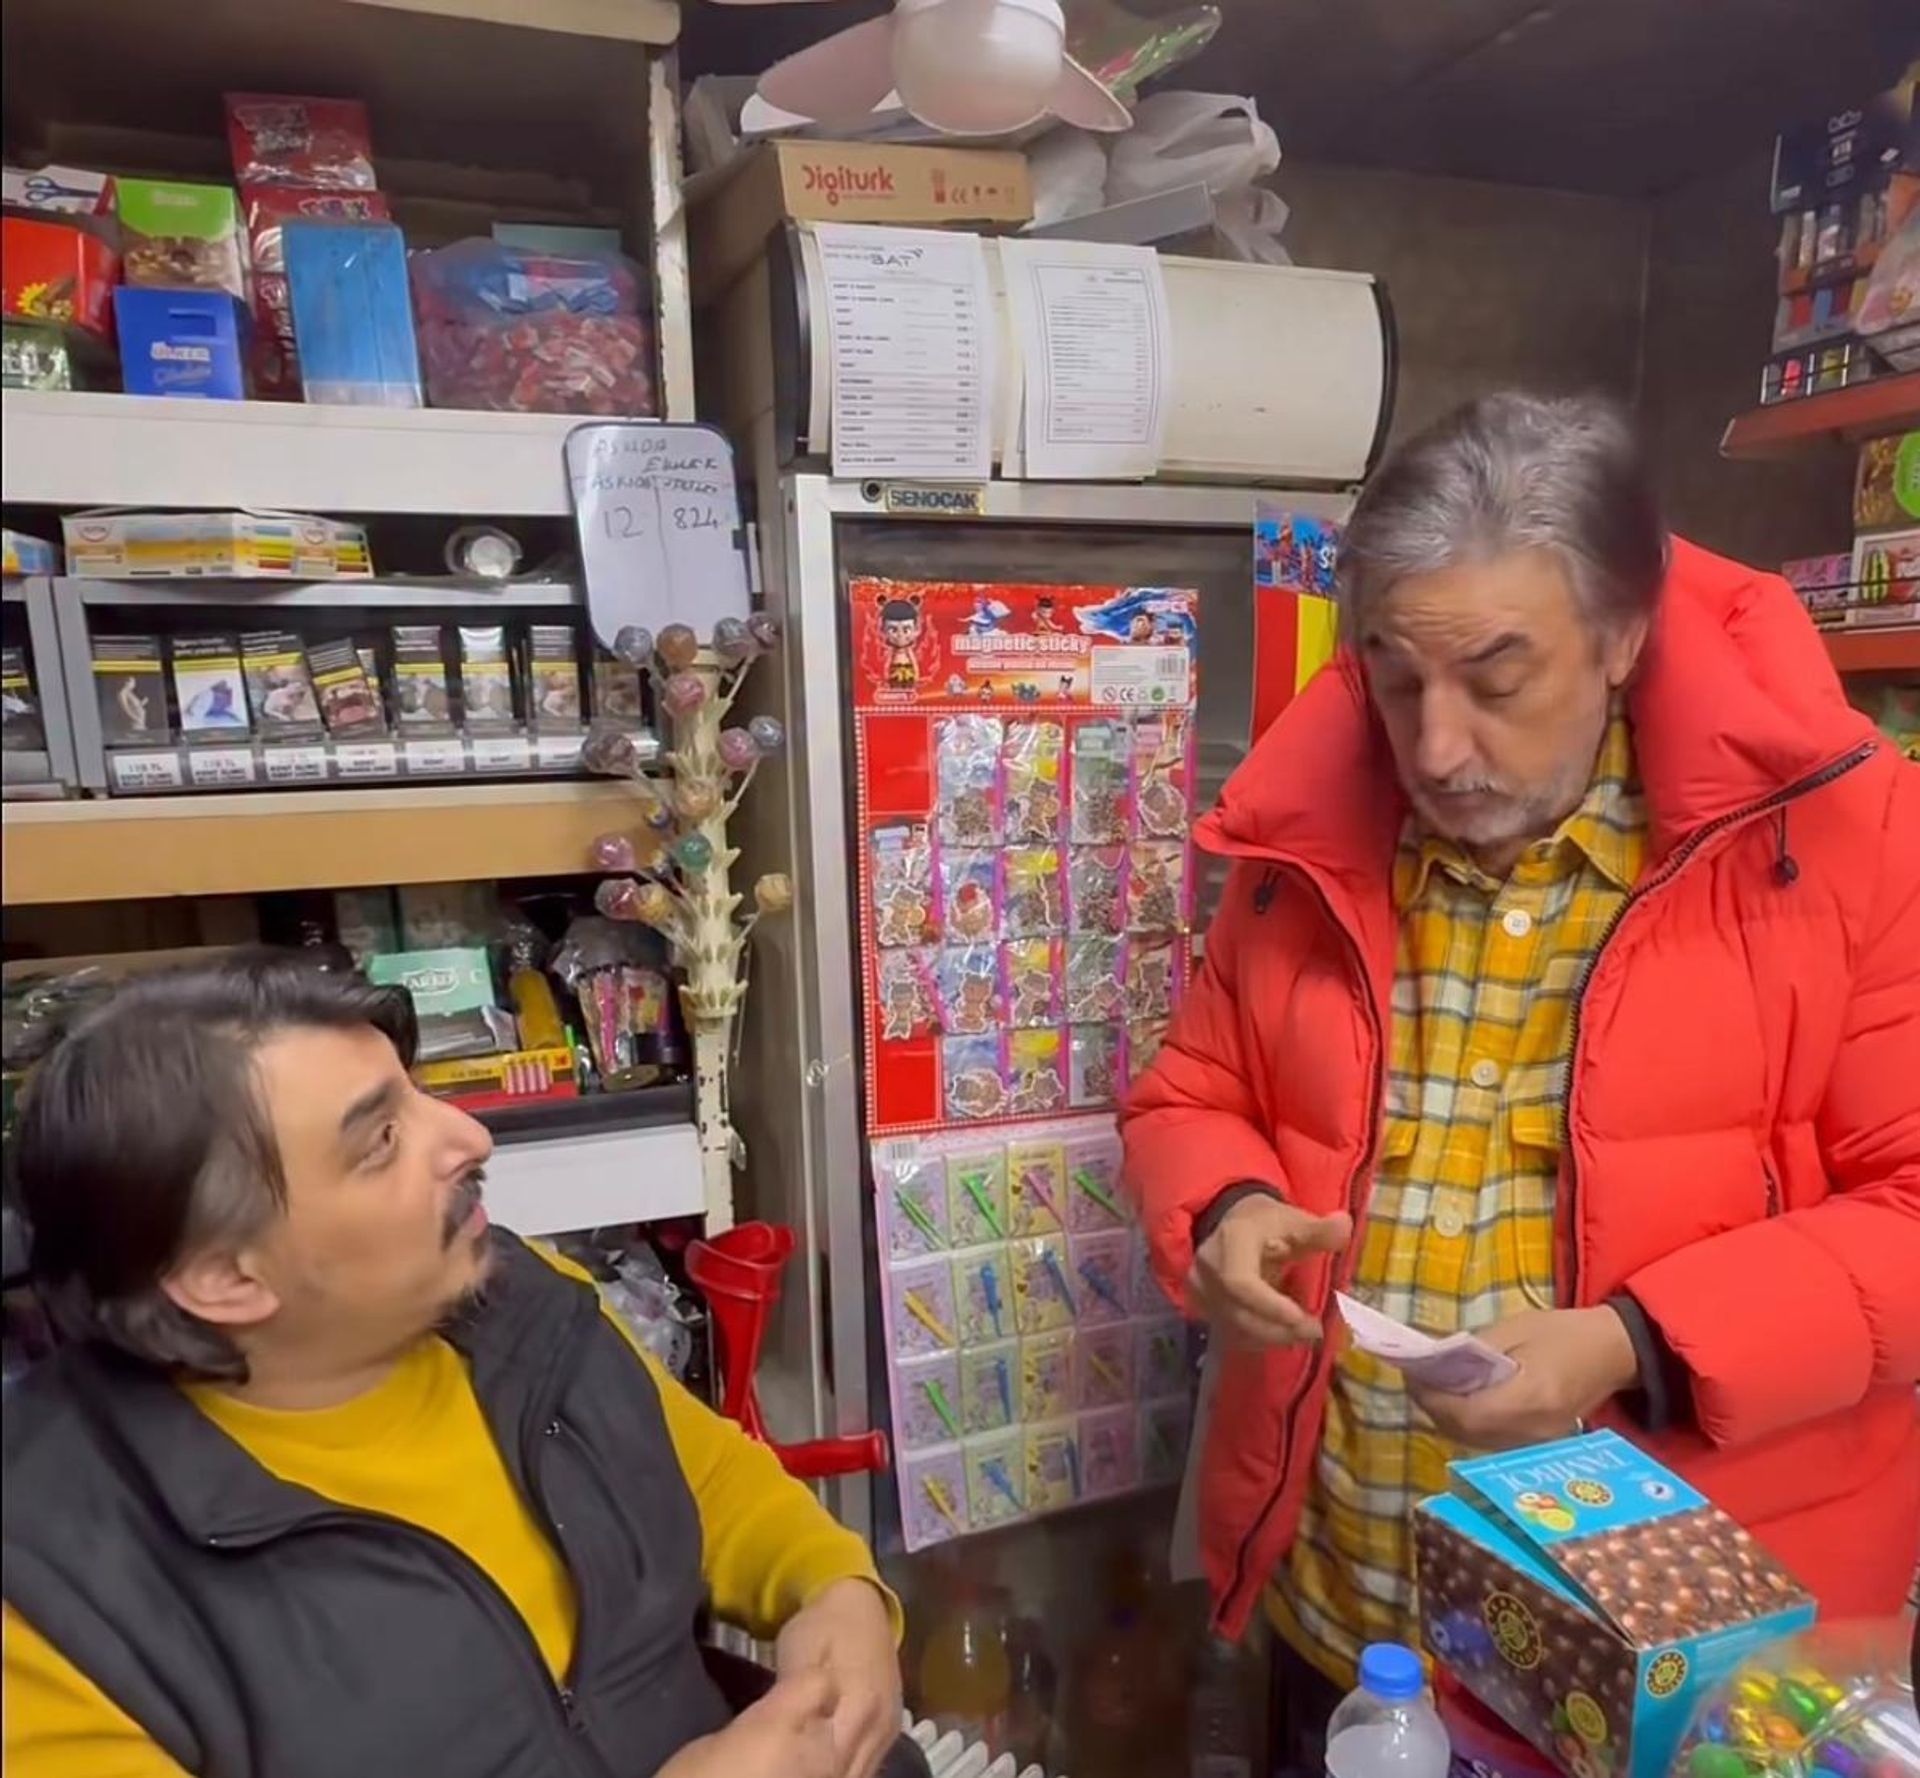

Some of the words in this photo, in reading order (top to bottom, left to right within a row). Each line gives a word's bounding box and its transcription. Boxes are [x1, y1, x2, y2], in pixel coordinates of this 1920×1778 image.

[802, 165, 895, 206] Digiturk
[603, 506, 644, 539] 12
[672, 506, 719, 530] 824
[953, 634, 1036, 654] magnetic
